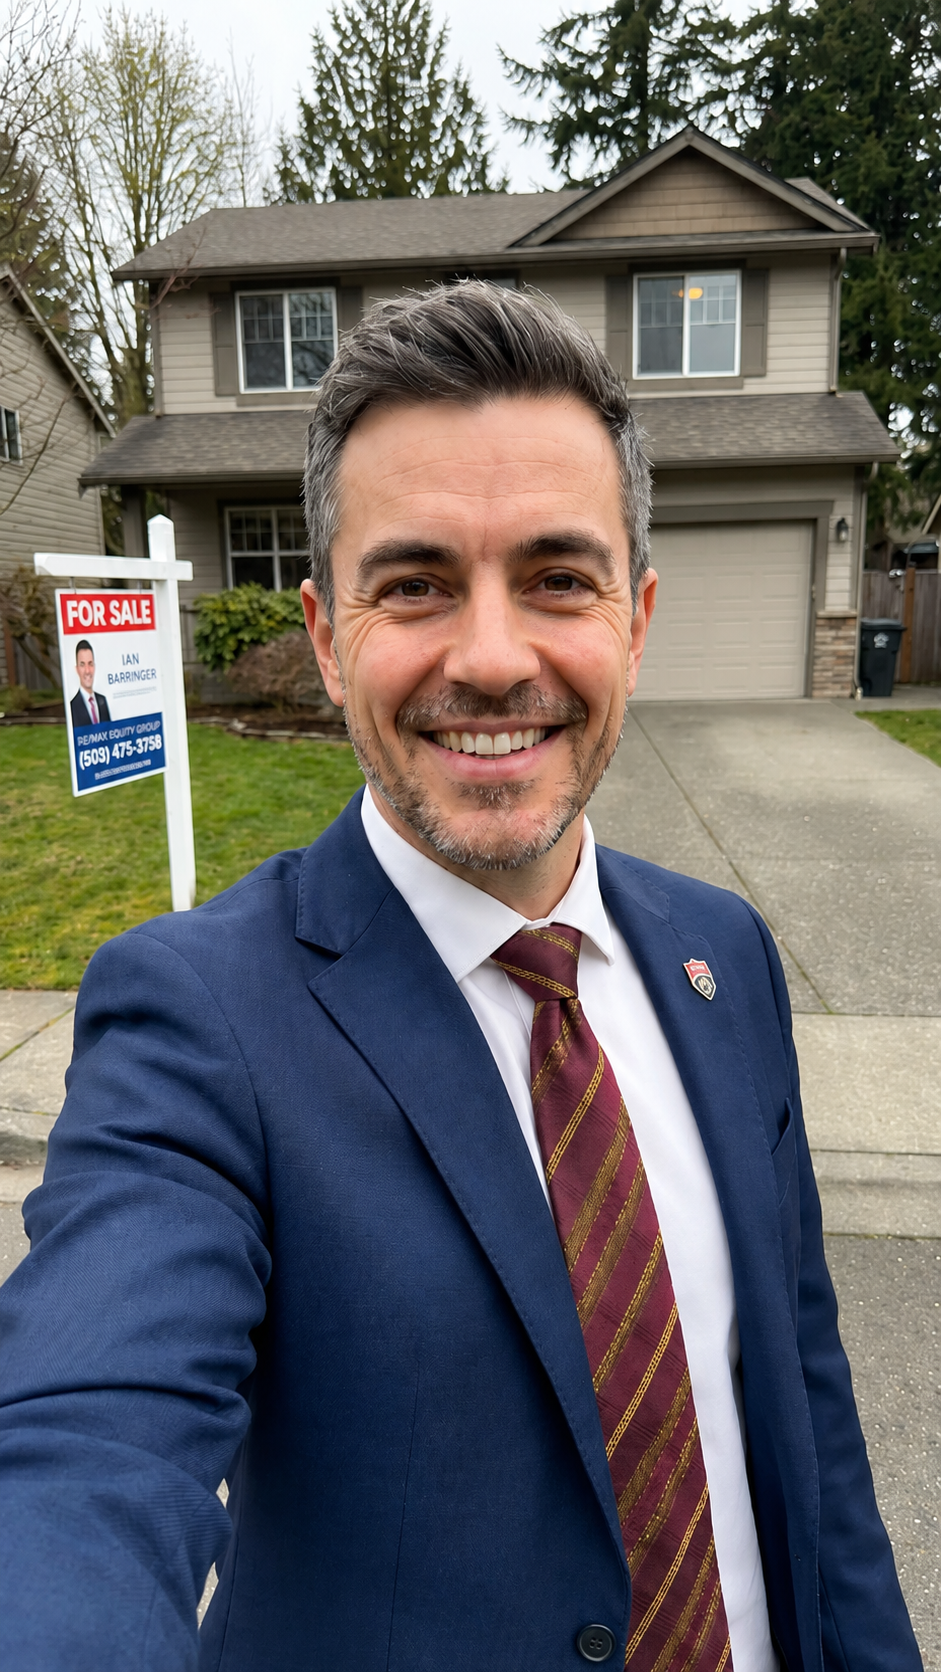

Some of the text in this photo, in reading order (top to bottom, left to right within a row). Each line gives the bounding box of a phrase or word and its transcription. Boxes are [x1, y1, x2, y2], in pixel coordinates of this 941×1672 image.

[66, 599, 152, 628] FOR SALE
[121, 652, 140, 666] IAN
[107, 668, 157, 685] BARRINGER
[112, 734, 162, 760] 475-3758
